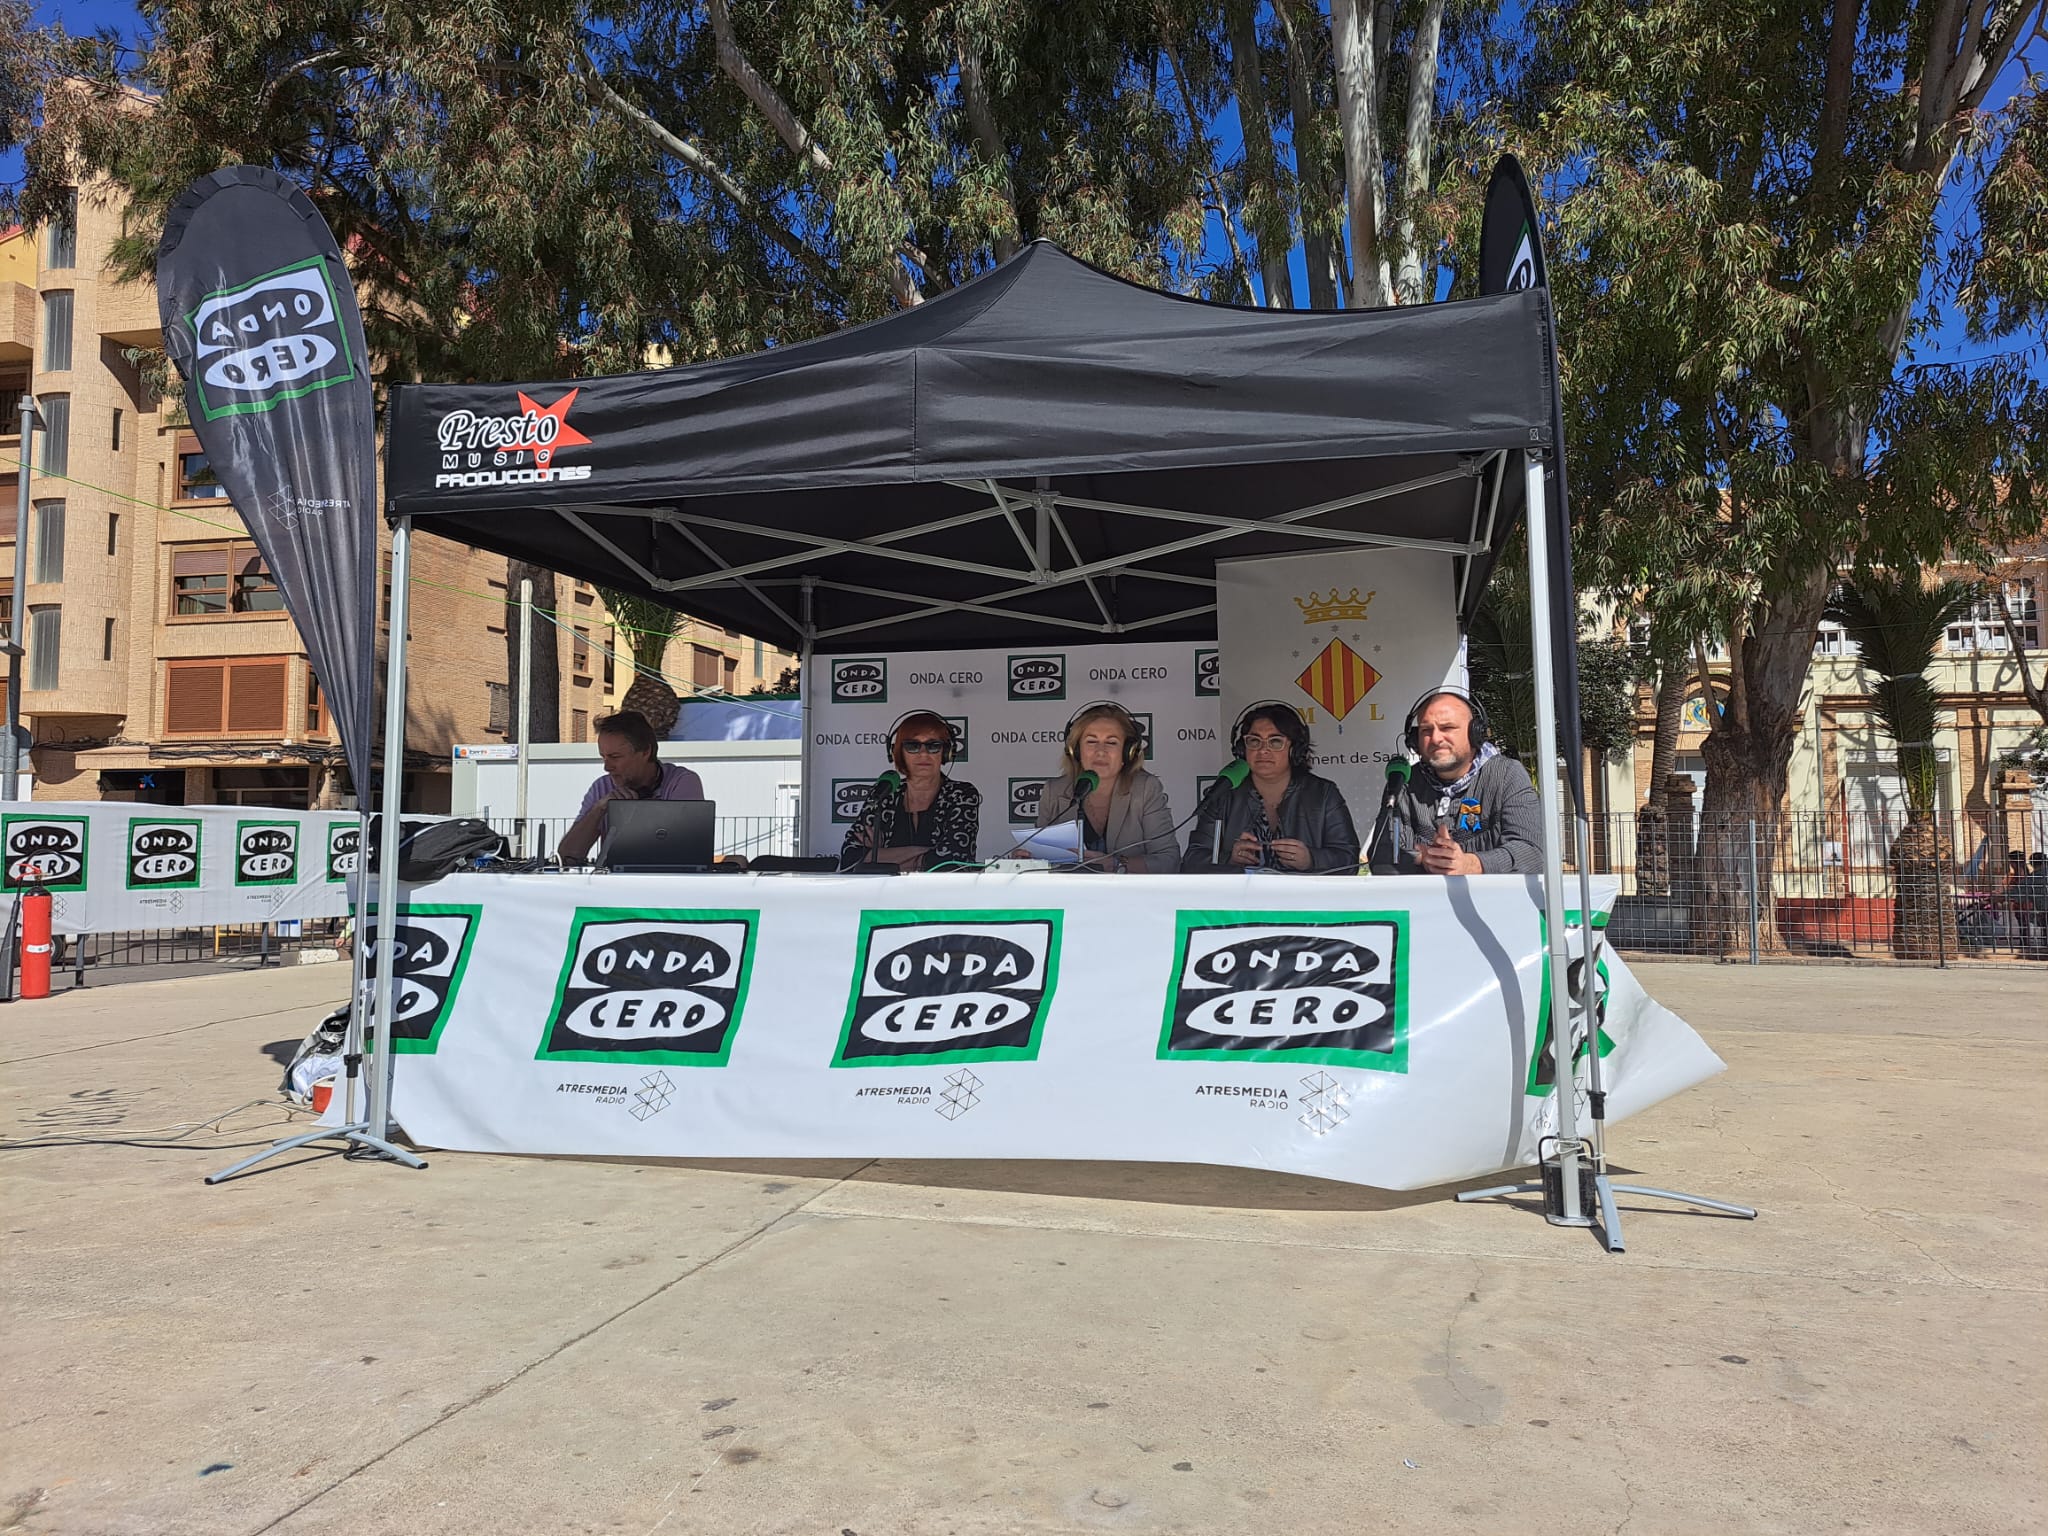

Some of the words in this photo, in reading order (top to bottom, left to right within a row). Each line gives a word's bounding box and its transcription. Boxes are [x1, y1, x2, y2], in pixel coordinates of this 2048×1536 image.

[437, 409, 559, 450] Presto
[442, 451, 551, 469] MUSIC
[840, 669, 877, 678] ONDA
[1017, 665, 1056, 674] ONDA
[1089, 668, 1127, 680] ONDA
[1131, 667, 1167, 679] CERO
[910, 672, 945, 684] ONDA
[949, 671, 983, 684] CERO
[843, 684, 877, 694] CERO
[1019, 680, 1056, 691] CERO
[1369, 703, 1384, 721] L
[815, 733, 850, 745] ONDA
[854, 732, 888, 745] CERO
[991, 732, 1027, 743] ONDA
[1031, 731, 1065, 743] CERO
[1177, 728, 1216, 741] ONDA
[1350, 752, 1369, 763] de
[841, 789, 868, 797] OND
[16, 834, 72, 848] ONDA
[141, 836, 188, 849] ONDA
[247, 837, 288, 848] ONDA
[143, 859, 187, 873] CERO
[249, 858, 287, 871] CERO
[597, 948, 714, 974] ONDA
[891, 953, 1017, 981] ONDA
[1212, 949, 1360, 974] ONDA
[590, 999, 705, 1028] CERO
[1214, 996, 1358, 1025] CERO
[885, 1003, 1009, 1032] CERO
[557, 1083, 628, 1095] ATRESMEDIA
[856, 1086, 932, 1097] ATRESMEDIA
[1195, 1085, 1288, 1099] ATRESMEDIA
[595, 1096, 626, 1104] RADIO
[897, 1096, 930, 1105] RADIO
[1249, 1099, 1288, 1109] RADIO
